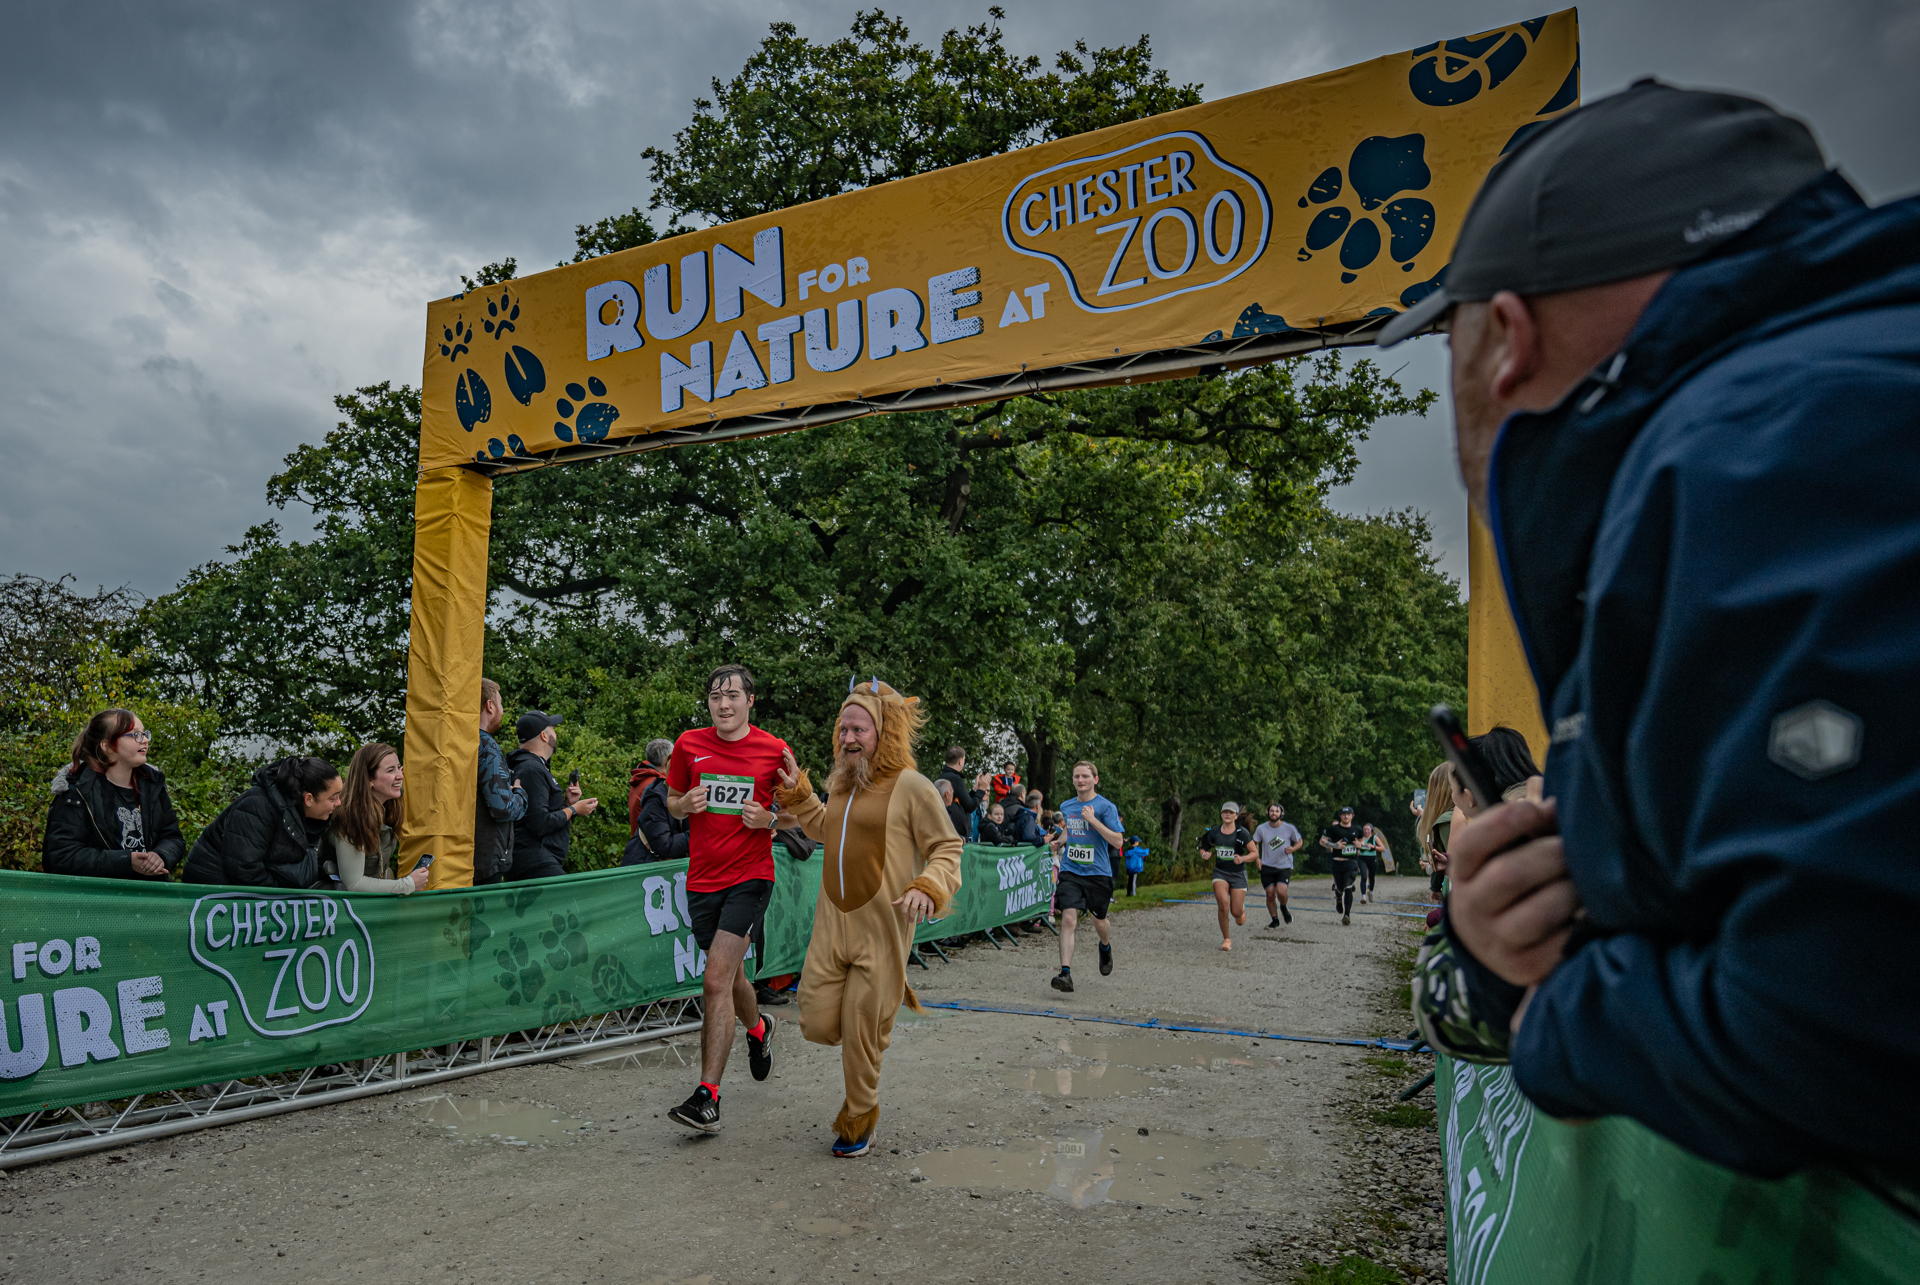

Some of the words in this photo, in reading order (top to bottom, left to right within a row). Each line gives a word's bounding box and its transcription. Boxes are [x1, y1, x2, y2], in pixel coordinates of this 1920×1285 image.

[1019, 150, 1198, 237] CHESTER
[1096, 188, 1245, 297] ZOO
[586, 227, 784, 361] RUN
[799, 257, 870, 300] FOR
[660, 266, 983, 413] NATURE
[999, 283, 1050, 328] AT
[706, 784, 751, 805] 1627
[1068, 848, 1091, 860] 5061
[1005, 881, 1038, 916] NATURE
[206, 899, 338, 949] CHESTER
[12, 935, 102, 979] FOR
[263, 939, 359, 1018] ZOO
[188, 1000, 229, 1042] AT
